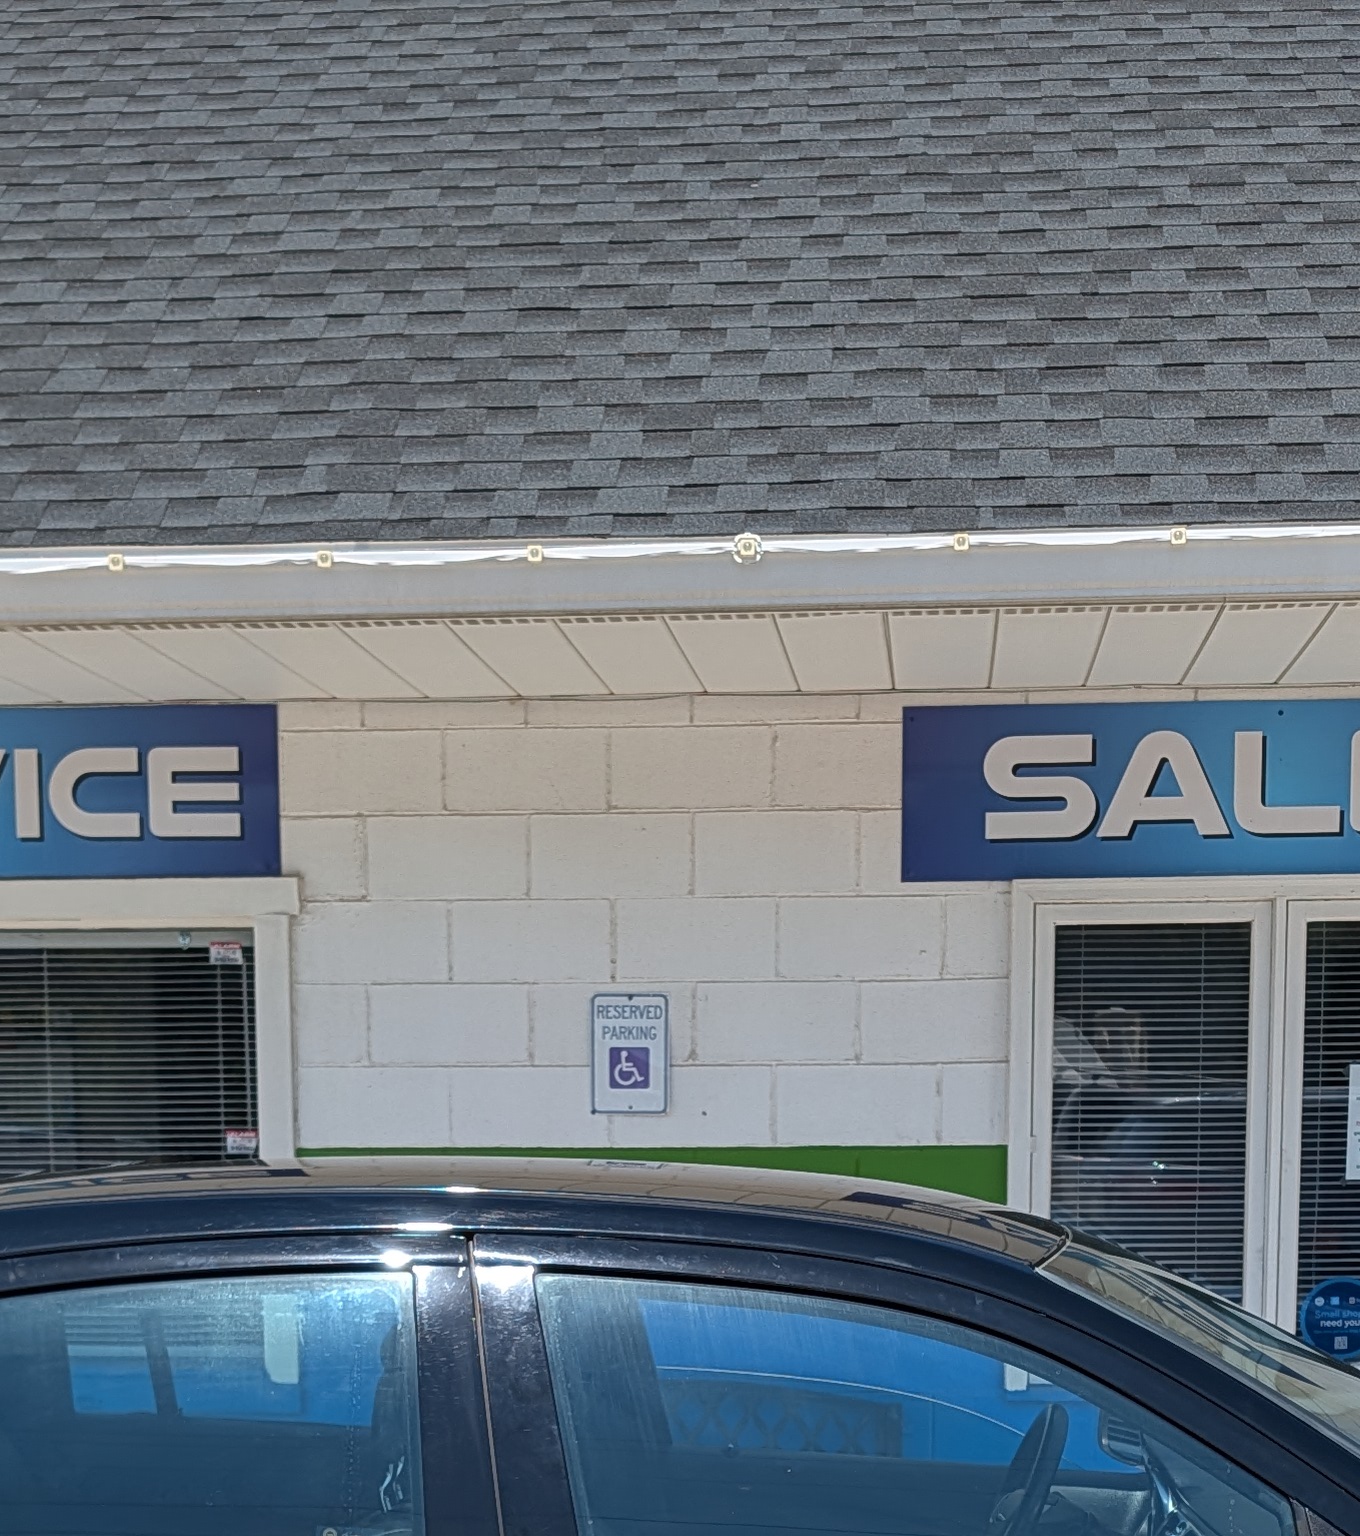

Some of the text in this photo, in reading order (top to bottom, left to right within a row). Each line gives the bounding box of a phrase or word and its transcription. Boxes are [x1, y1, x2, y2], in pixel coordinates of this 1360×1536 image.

[596, 1004, 663, 1020] RESERVED
[601, 1026, 658, 1040] PARKING
[1314, 1310, 1341, 1319] Small
